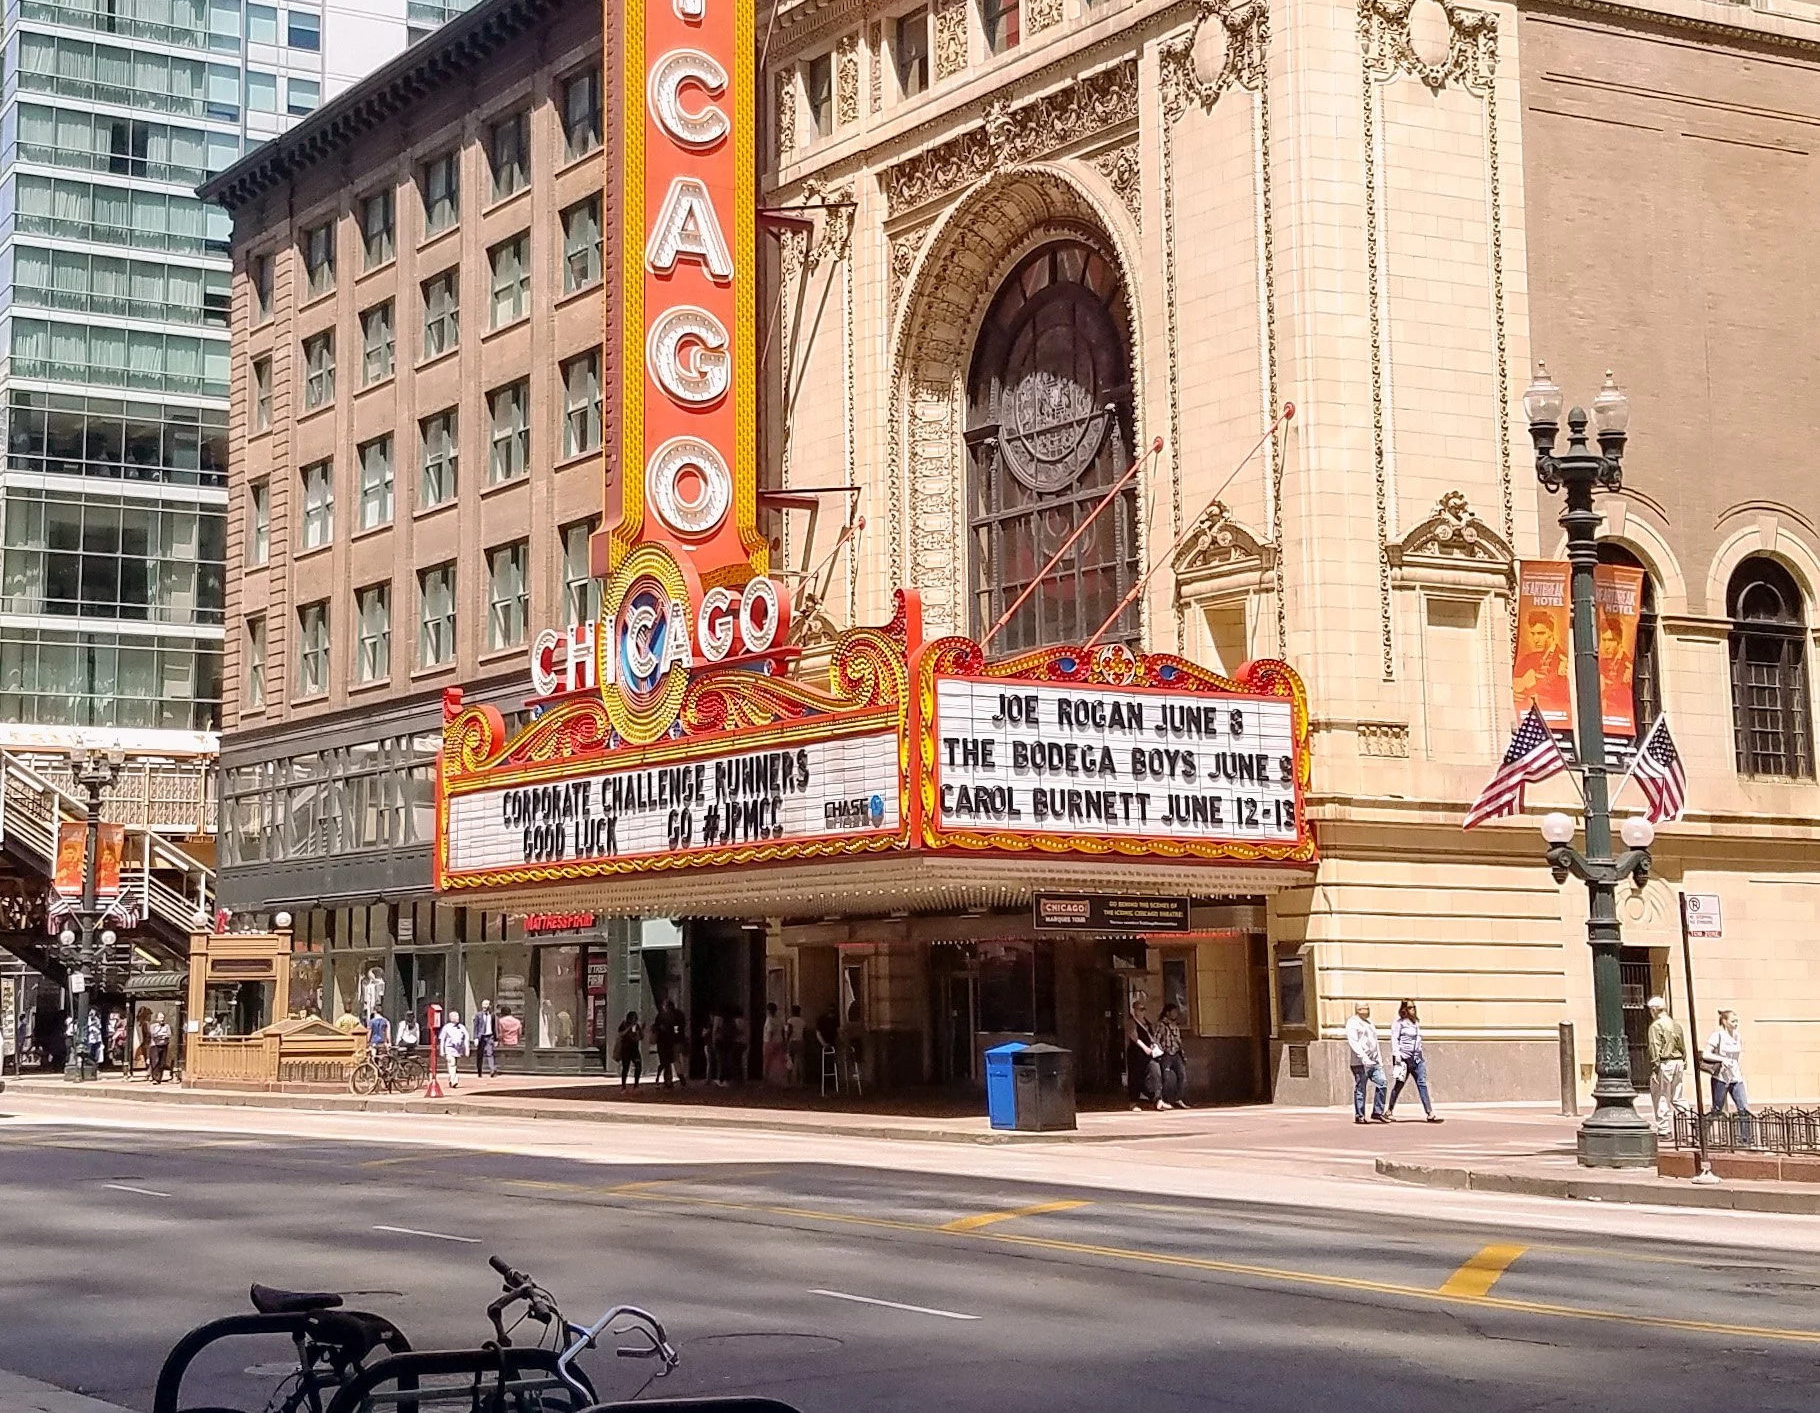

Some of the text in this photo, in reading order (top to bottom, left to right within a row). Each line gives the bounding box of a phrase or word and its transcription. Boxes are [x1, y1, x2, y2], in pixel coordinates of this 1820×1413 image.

[1521, 581, 1565, 597] HEARTBREAK
[1533, 596, 1565, 607] HOTEL
[1605, 604, 1636, 615] HOTEL
[531, 576, 779, 695] CHICAGO
[992, 693, 1244, 736] JOE ROGAN JUNE 8
[943, 737, 1293, 783] THE BODEGA BOYS JUNE 9
[503, 749, 810, 827] CORPORATE CHALLENGE RUNNERS
[824, 798, 868, 818] CHASE
[940, 783, 1021, 815] CAROL
[1033, 787, 1151, 822] BURNETT
[1161, 794, 1223, 825] JUNE
[523, 796, 784, 862] GOOD LUCK GO #JPMCC
[1045, 903, 1085, 913] CHICAGO
